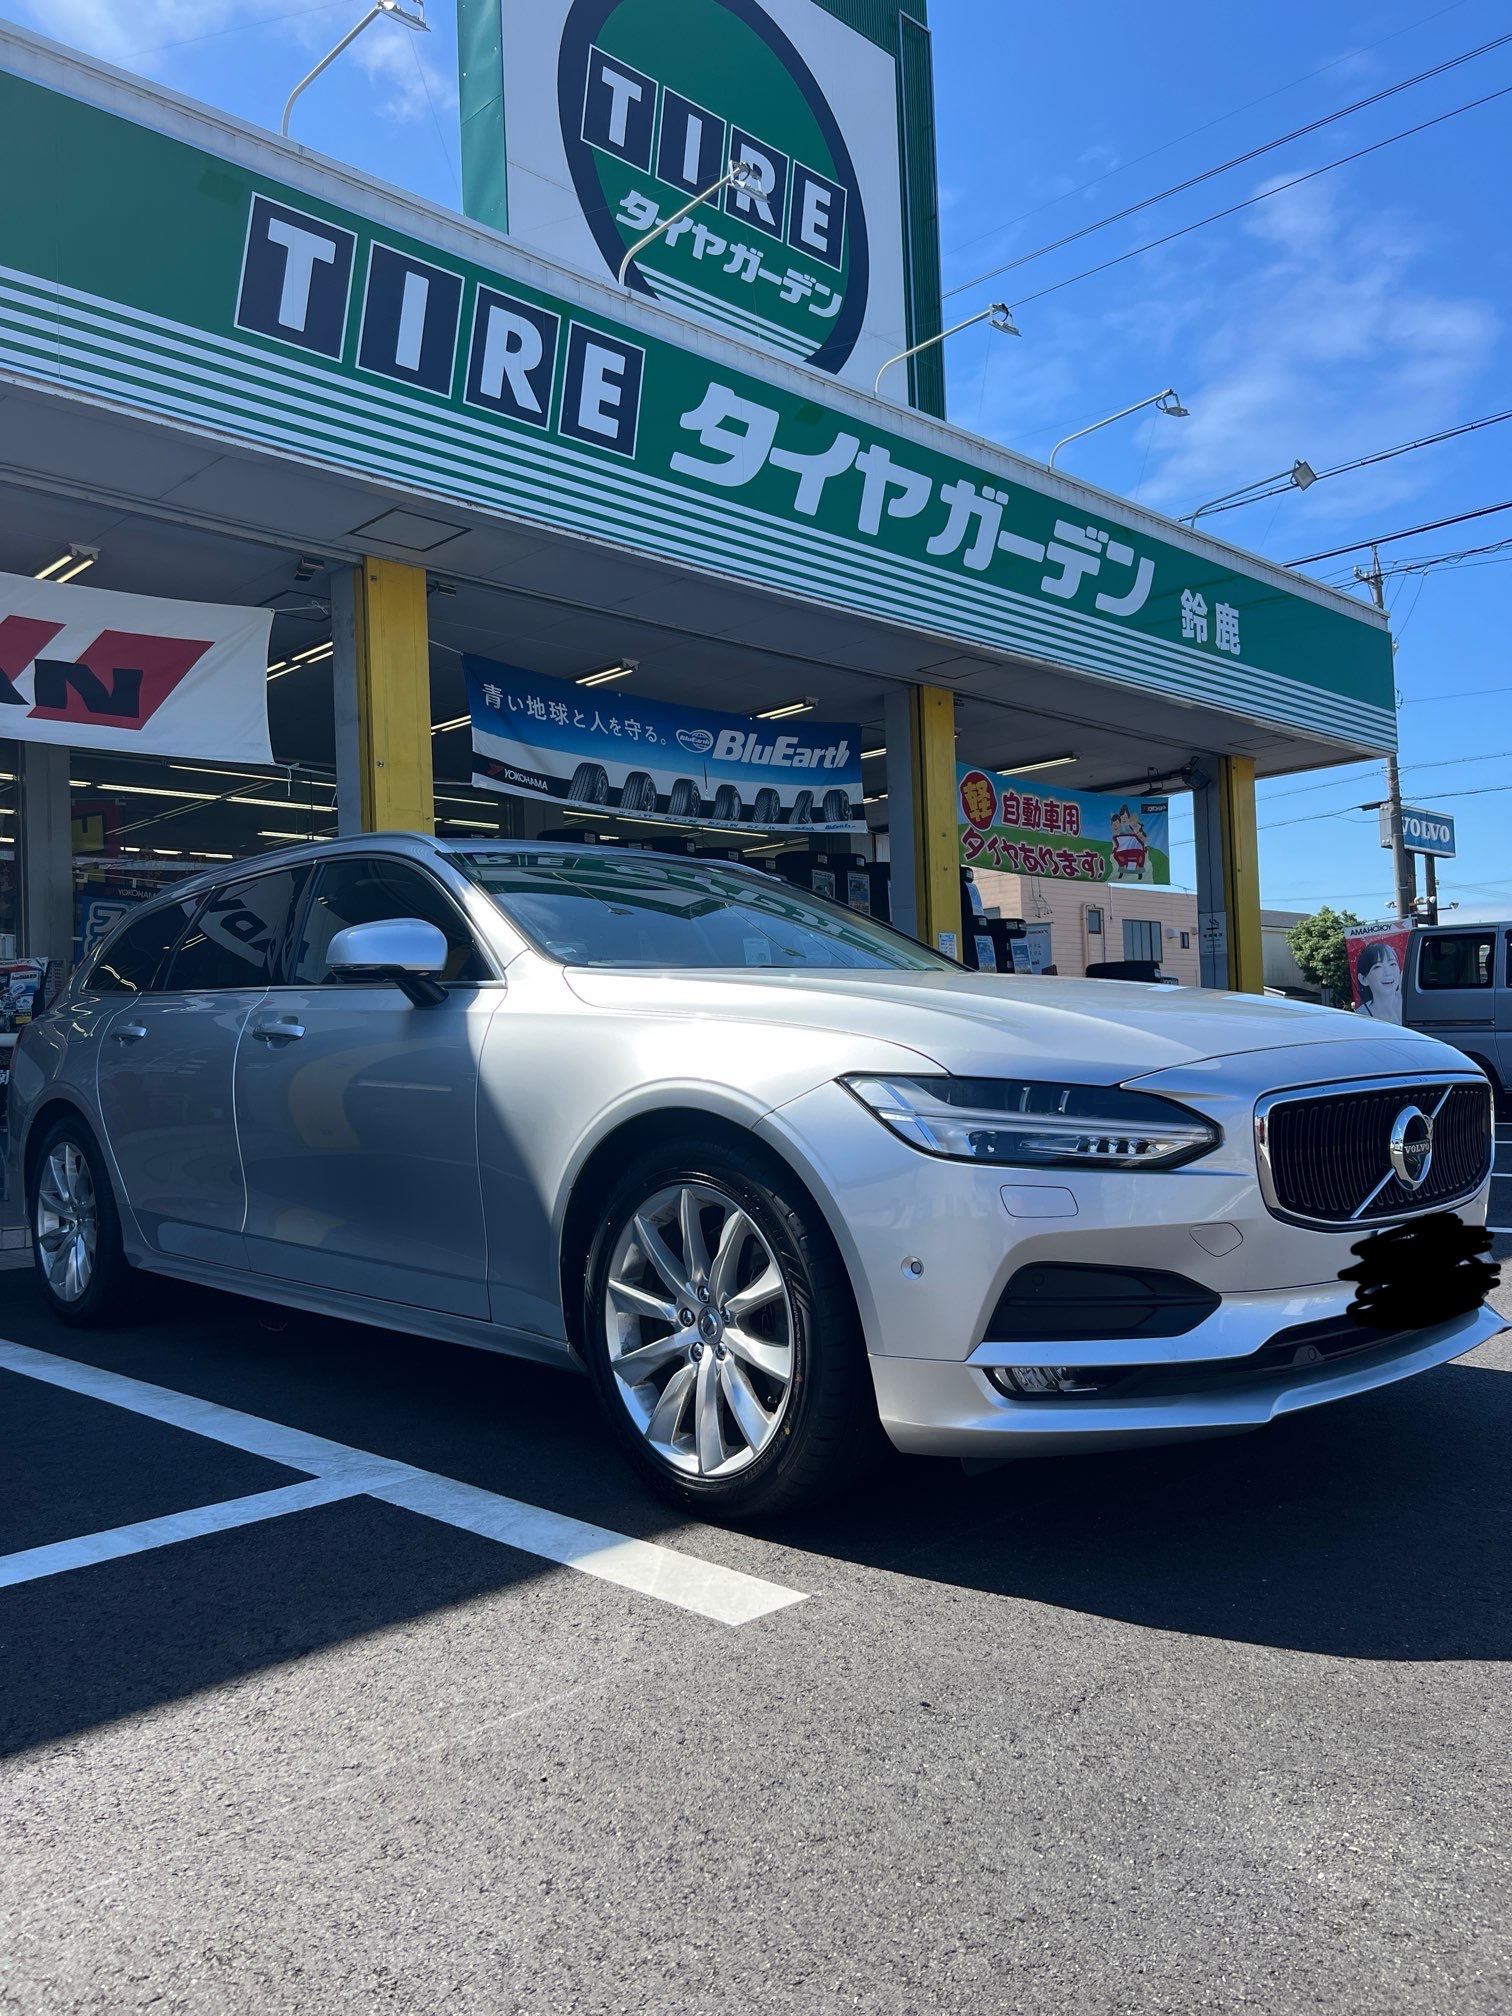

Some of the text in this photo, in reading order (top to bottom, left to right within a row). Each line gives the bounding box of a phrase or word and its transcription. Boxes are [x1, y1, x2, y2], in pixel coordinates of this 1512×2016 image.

[601, 65, 832, 253] TIRE
[615, 189, 843, 319] タイヤガーデン
[267, 217, 1241, 656] TIRE タイヤガーデン 鈴鹿
[481, 682, 851, 769] 青い地球と人を守る。 BluEarth
[503, 768, 549, 791] YOKOHAMA
[960, 826, 1105, 880] タイヤあります!
[1401, 815, 1450, 843] VOLVO
[1404, 1142, 1430, 1154] VOLVO
